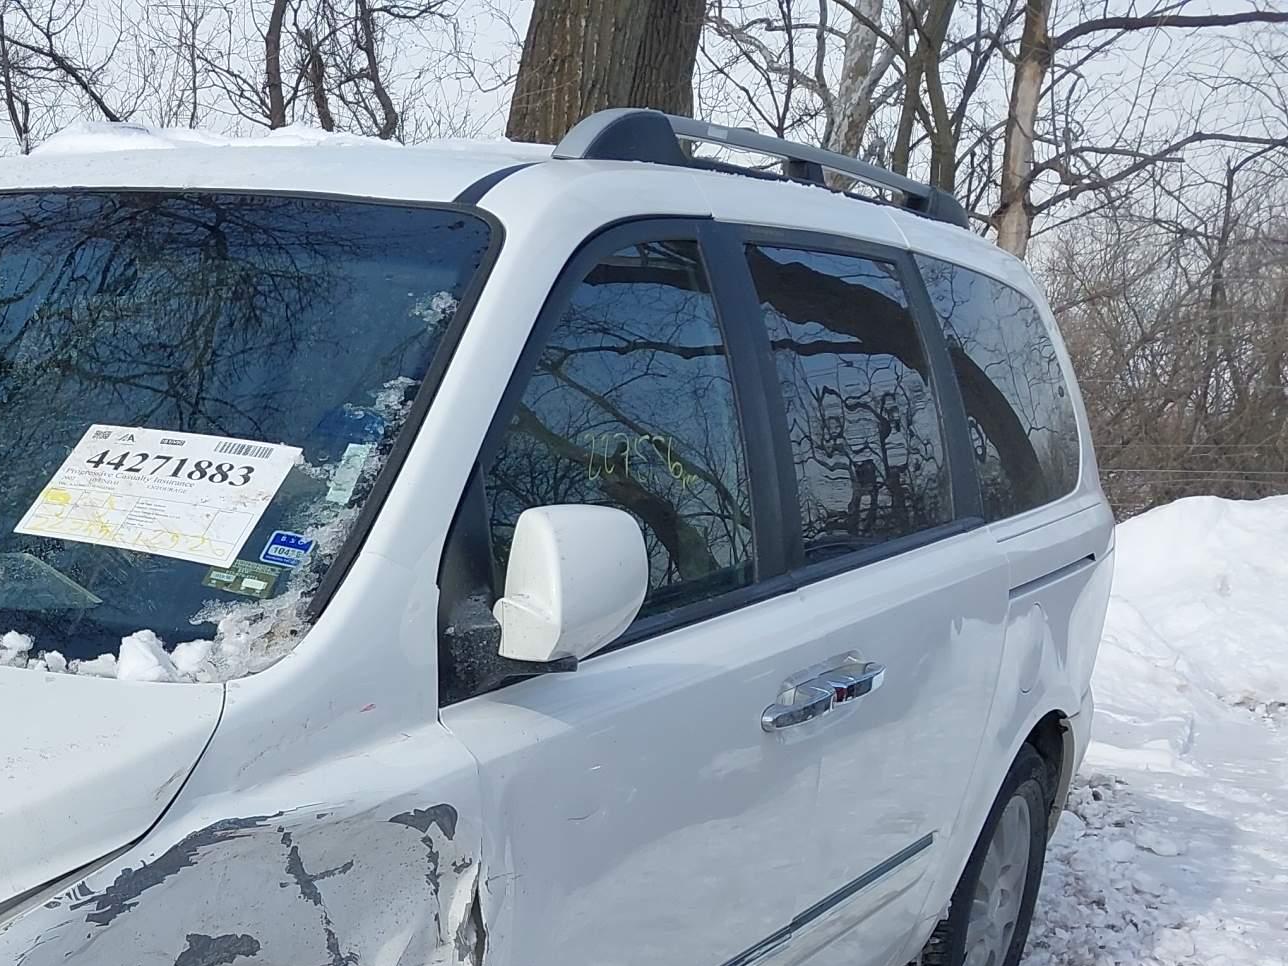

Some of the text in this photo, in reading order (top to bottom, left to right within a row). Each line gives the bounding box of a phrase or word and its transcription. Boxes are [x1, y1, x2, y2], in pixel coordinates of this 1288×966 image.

[65, 467, 195, 489] Progressive Casualty Insurance
[86, 449, 255, 487] 44271883
